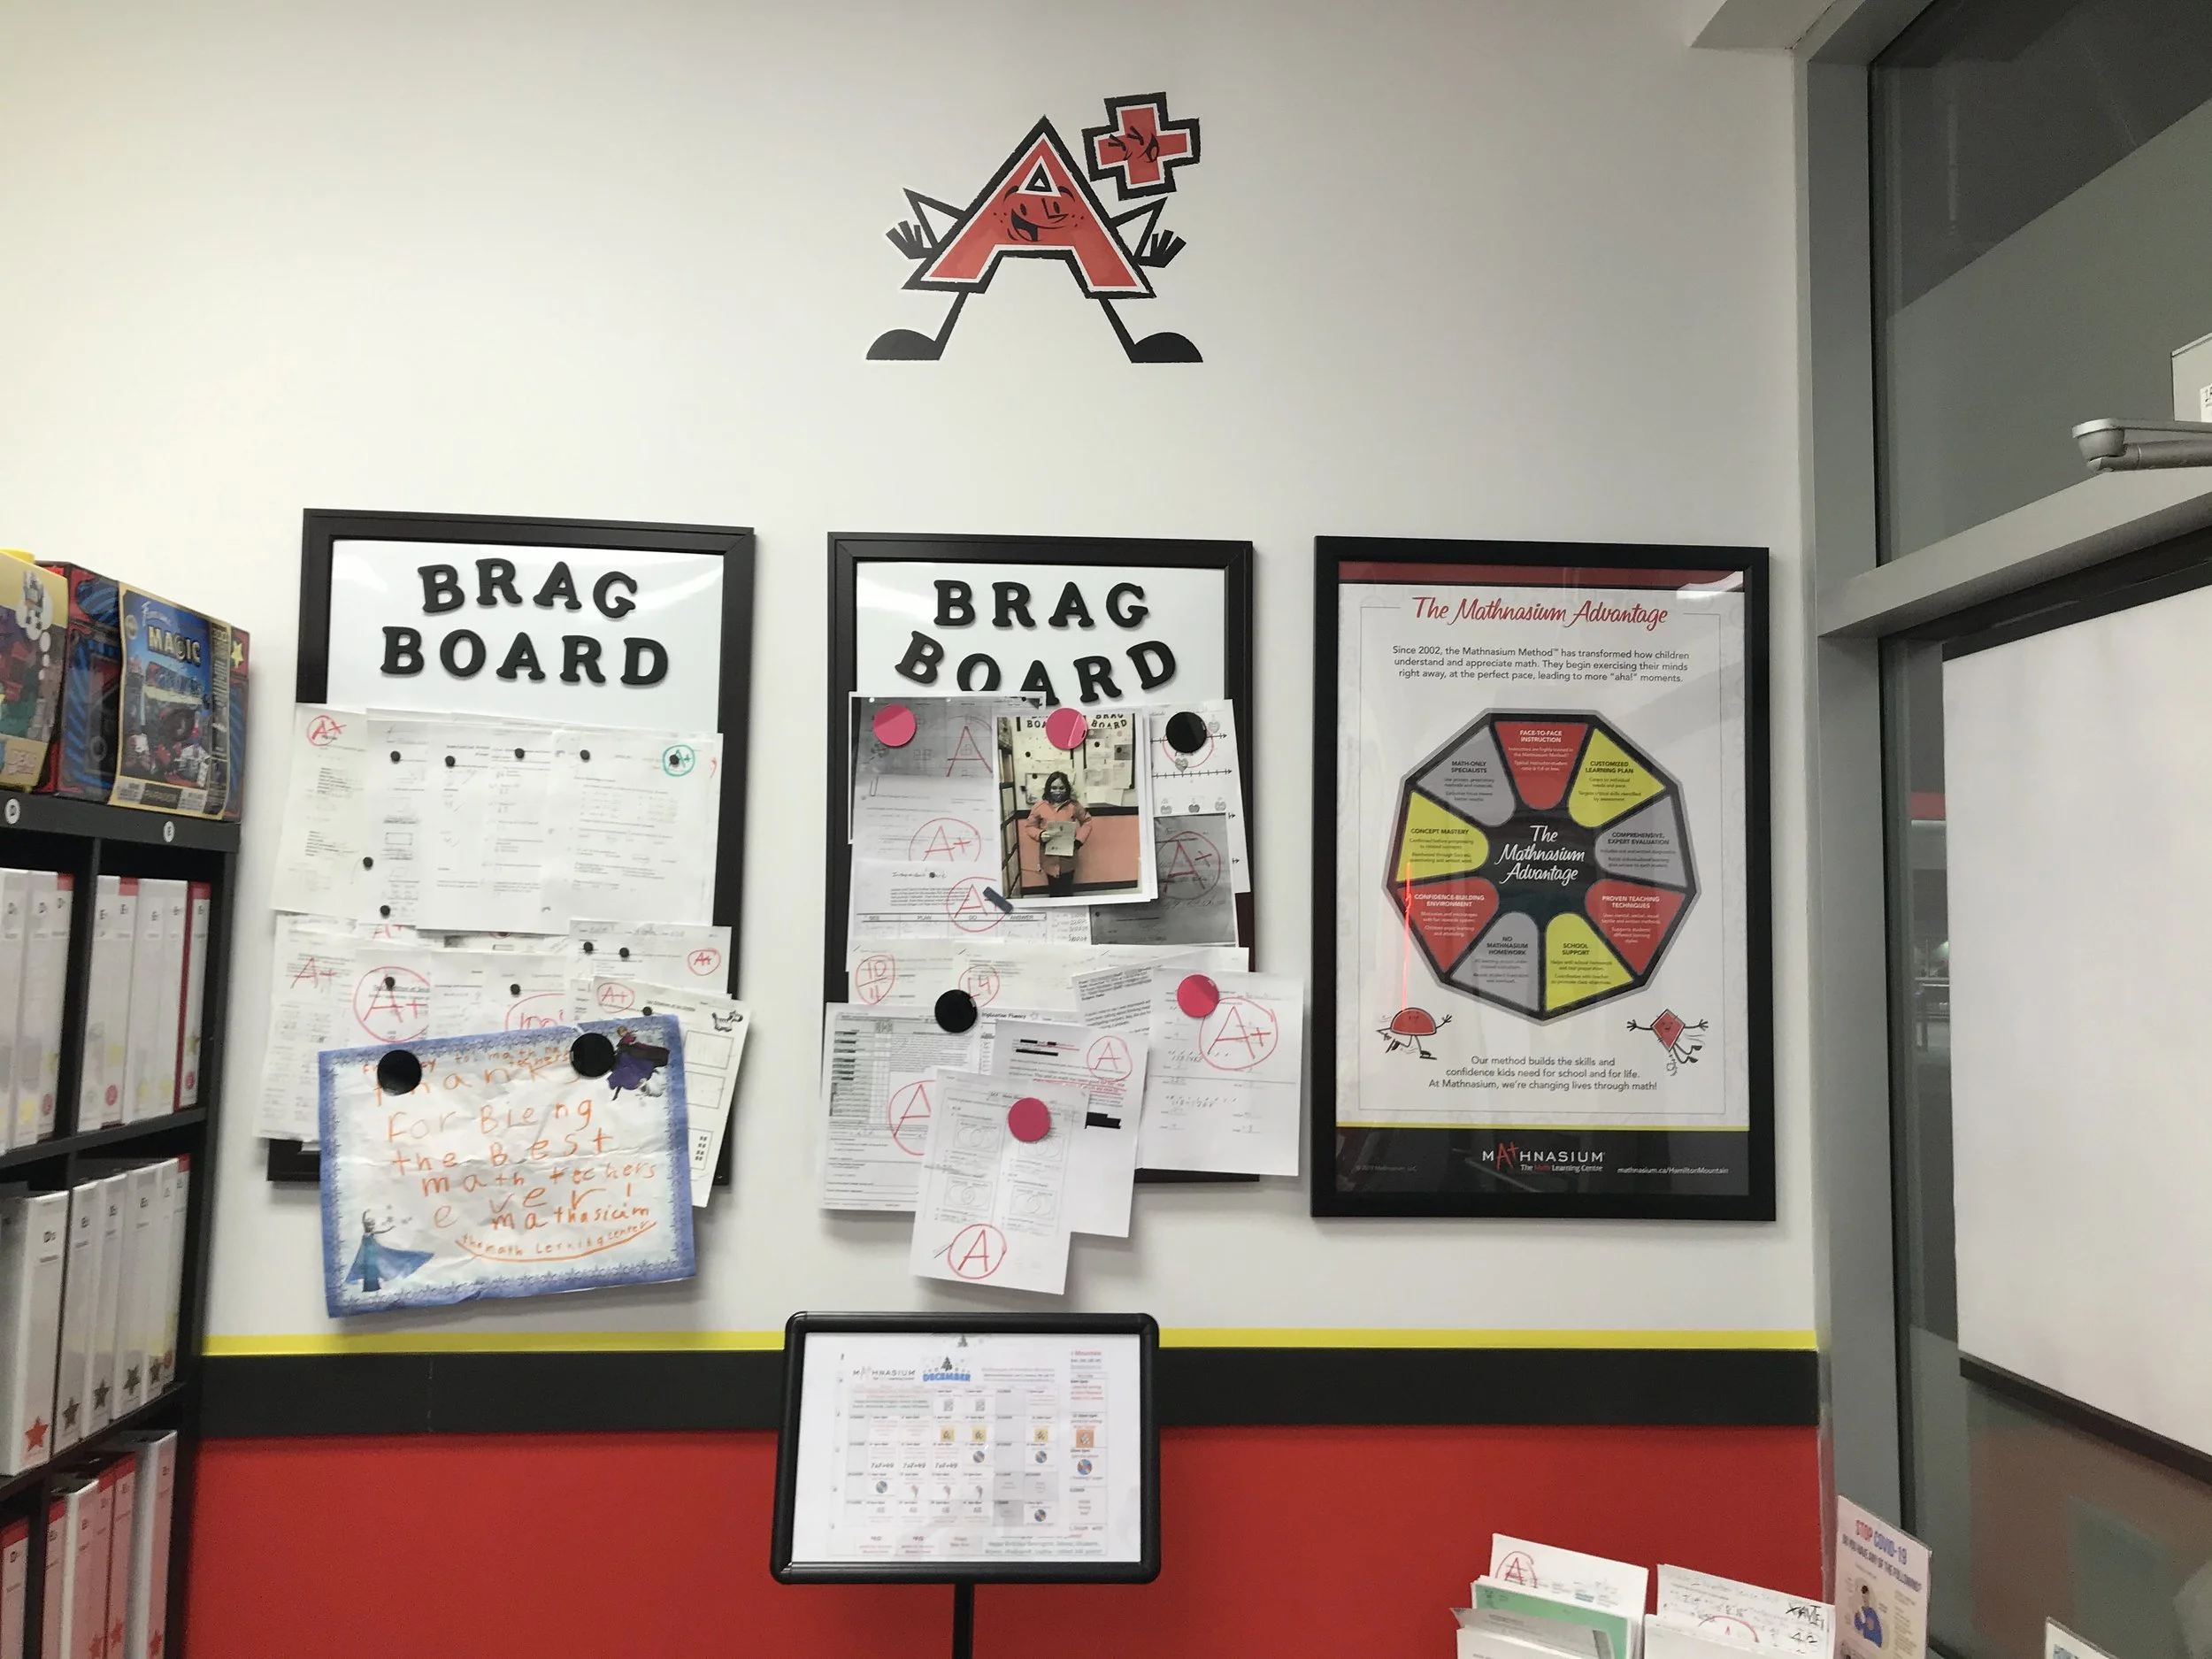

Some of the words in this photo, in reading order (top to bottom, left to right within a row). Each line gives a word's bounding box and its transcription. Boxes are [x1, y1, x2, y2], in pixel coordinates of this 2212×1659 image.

[418, 557, 637, 619] BRAG
[933, 579, 1148, 628] BRAG
[1412, 596, 1448, 619] The
[1448, 598, 1566, 625] Mathnasium
[1563, 600, 1668, 631] Advantage
[148, 625, 201, 668] MAGIC
[380, 626, 669, 687] BOARD
[1393, 645, 1416, 656] Since
[1418, 647, 1442, 657] 2002,
[1446, 647, 1460, 656] the
[1463, 647, 1516, 657] Mathnasium
[1561, 649, 1576, 657] has
[1578, 649, 1632, 658] transformed
[1634, 650, 1653, 659] how
[1655, 650, 1690, 660] children
[895, 630, 1177, 706] BOARD
[1394, 657, 1445, 666] understand
[1447, 657, 1463, 666] and
[1465, 659, 1513, 670] appreciate
[1515, 659, 1540, 668] math.
[1542, 660, 1563, 671] They
[1566, 661, 1591, 672] begin
[1594, 662, 1637, 672] exercising
[1639, 662, 1660, 671] their
[1662, 663, 1688, 672] minds
[1399, 669, 1420, 680] right
[1423, 672, 1446, 680] away,
[1461, 670, 1475, 679] the
[1478, 671, 1509, 681] perfect
[1511, 673, 1535, 682] pace,
[1538, 672, 1571, 682] leading
[1640, 674, 1683, 683] moments.
[1530, 825, 1558, 842] The
[1494, 843, 1586, 865] Mathnasium
[1499, 863, 1578, 887] Advantage
[1207, 1005, 1271, 1060] A+
[1094, 1041, 1122, 1071] A
[1471, 1056, 1488, 1065] Our
[1491, 1056, 1526, 1065] method
[1557, 1057, 1572, 1066] the
[1575, 1057, 1595, 1066] skills
[1598, 1057, 1616, 1066] and
[1428, 1079, 1440, 1087] At
[1442, 1079, 1499, 1089] Mathnasium,
[1528, 1080, 1570, 1091] changing
[1571, 1080, 1592, 1089] lives
[1594, 1080, 1630, 1092] through
[1632, 1081, 1657, 1090] math!
[1446, 1068, 1495, 1077] confidence
[1496, 1068, 1515, 1077] kids
[1542, 1069, 1555, 1078] for
[1557, 1069, 1586, 1078] school
[1589, 1069, 1606, 1078] and
[1608, 1069, 1622, 1078] for
[1624, 1070, 1640, 1079] life.
[392, 1150, 458, 1176] the
[1551, 1164, 1580, 1173] Learning
[957, 1229, 990, 1272] A
[923, 1372, 971, 1382] DECEMBER
[1855, 1519, 1874, 1542] STOP
[1874, 1531, 1908, 1564] COVID-19
